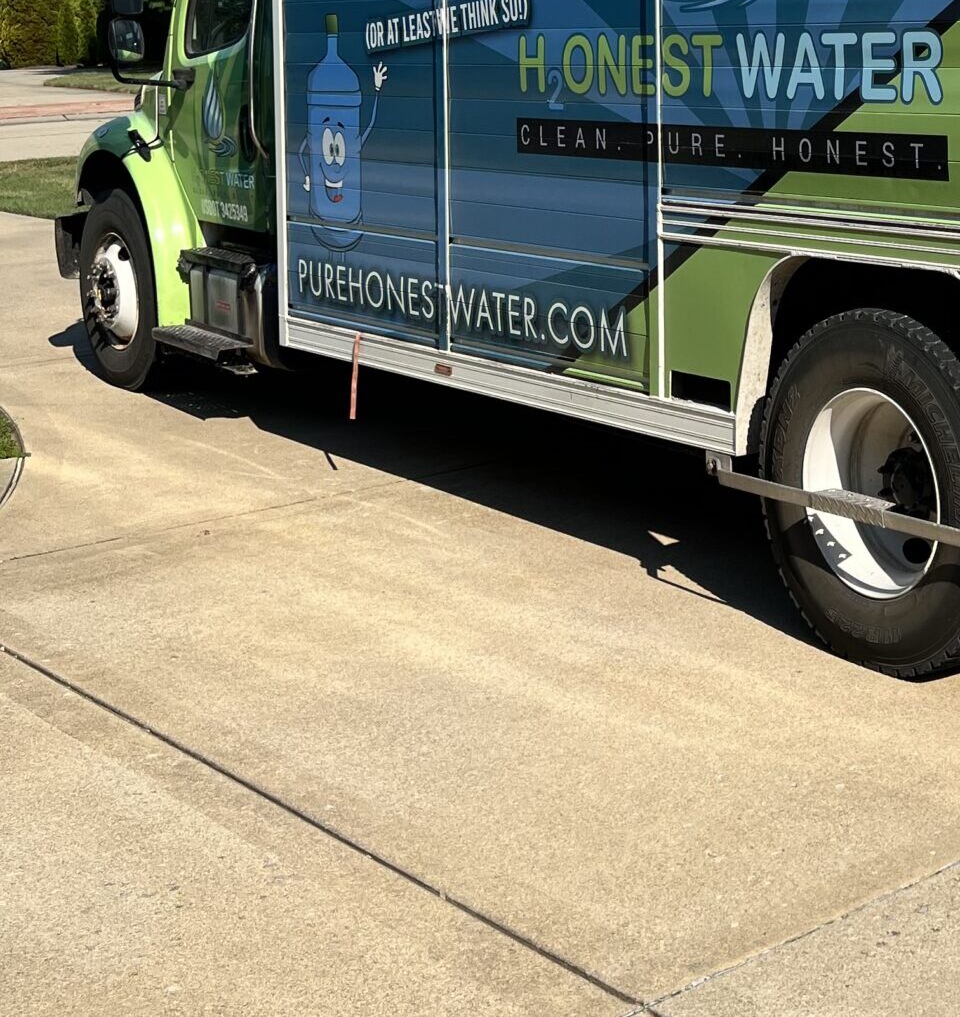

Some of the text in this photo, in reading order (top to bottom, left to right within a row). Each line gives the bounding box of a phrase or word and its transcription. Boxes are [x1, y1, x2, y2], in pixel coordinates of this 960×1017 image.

[365, 21, 384, 50] (OR
[387, 18, 399, 43] AT
[402, 10, 436, 42] LEAST
[436, 5, 458, 35] WE
[736, 31, 943, 103] WATER
[519, 124, 622, 152] CLEAN.
[772, 136, 942, 171] HONEST.
[225, 171, 255, 189] WATER
